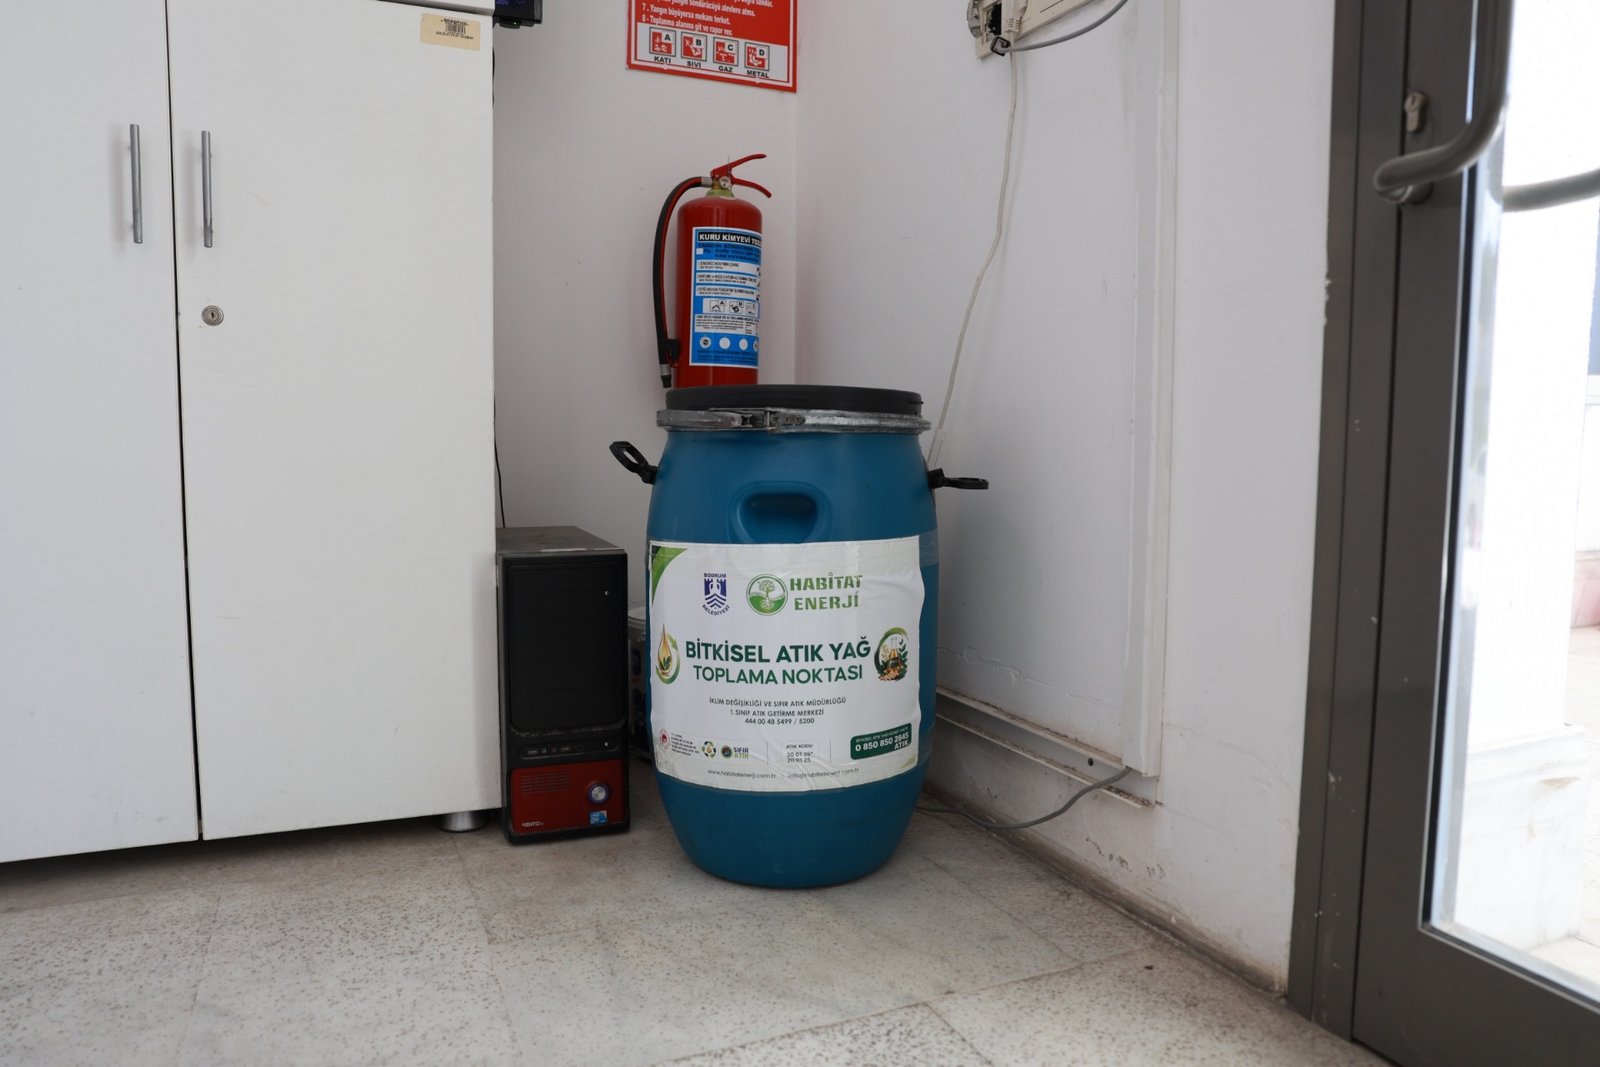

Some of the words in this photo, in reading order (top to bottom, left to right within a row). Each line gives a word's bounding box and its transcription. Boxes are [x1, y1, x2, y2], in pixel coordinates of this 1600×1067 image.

[642, 2, 646, 11] 7
[654, 56, 671, 64] KATI
[746, 70, 769, 78] METAL
[700, 233, 720, 241] KURU
[722, 233, 751, 244] KİMYEVİ
[790, 572, 863, 591] HABİTAT
[794, 591, 859, 611] ENERJİ
[702, 603, 730, 617] BELEDİYESİ
[685, 638, 771, 663] BİTKİSEL
[776, 643, 824, 663] ATIK
[829, 636, 871, 661] YAĞ
[693, 664, 778, 684] TOPLAMA
[782, 664, 863, 685] NOKTASI
[806, 696, 847, 706] MÜDÜRLÜĞÜ
[767, 709, 795, 717] GETİRME
[797, 708, 824, 716] MERKEZİ
[855, 743, 862, 752] 0
[863, 740, 879, 750] 850
[880, 737, 894, 747] 850
[894, 739, 909, 750] ATIK
